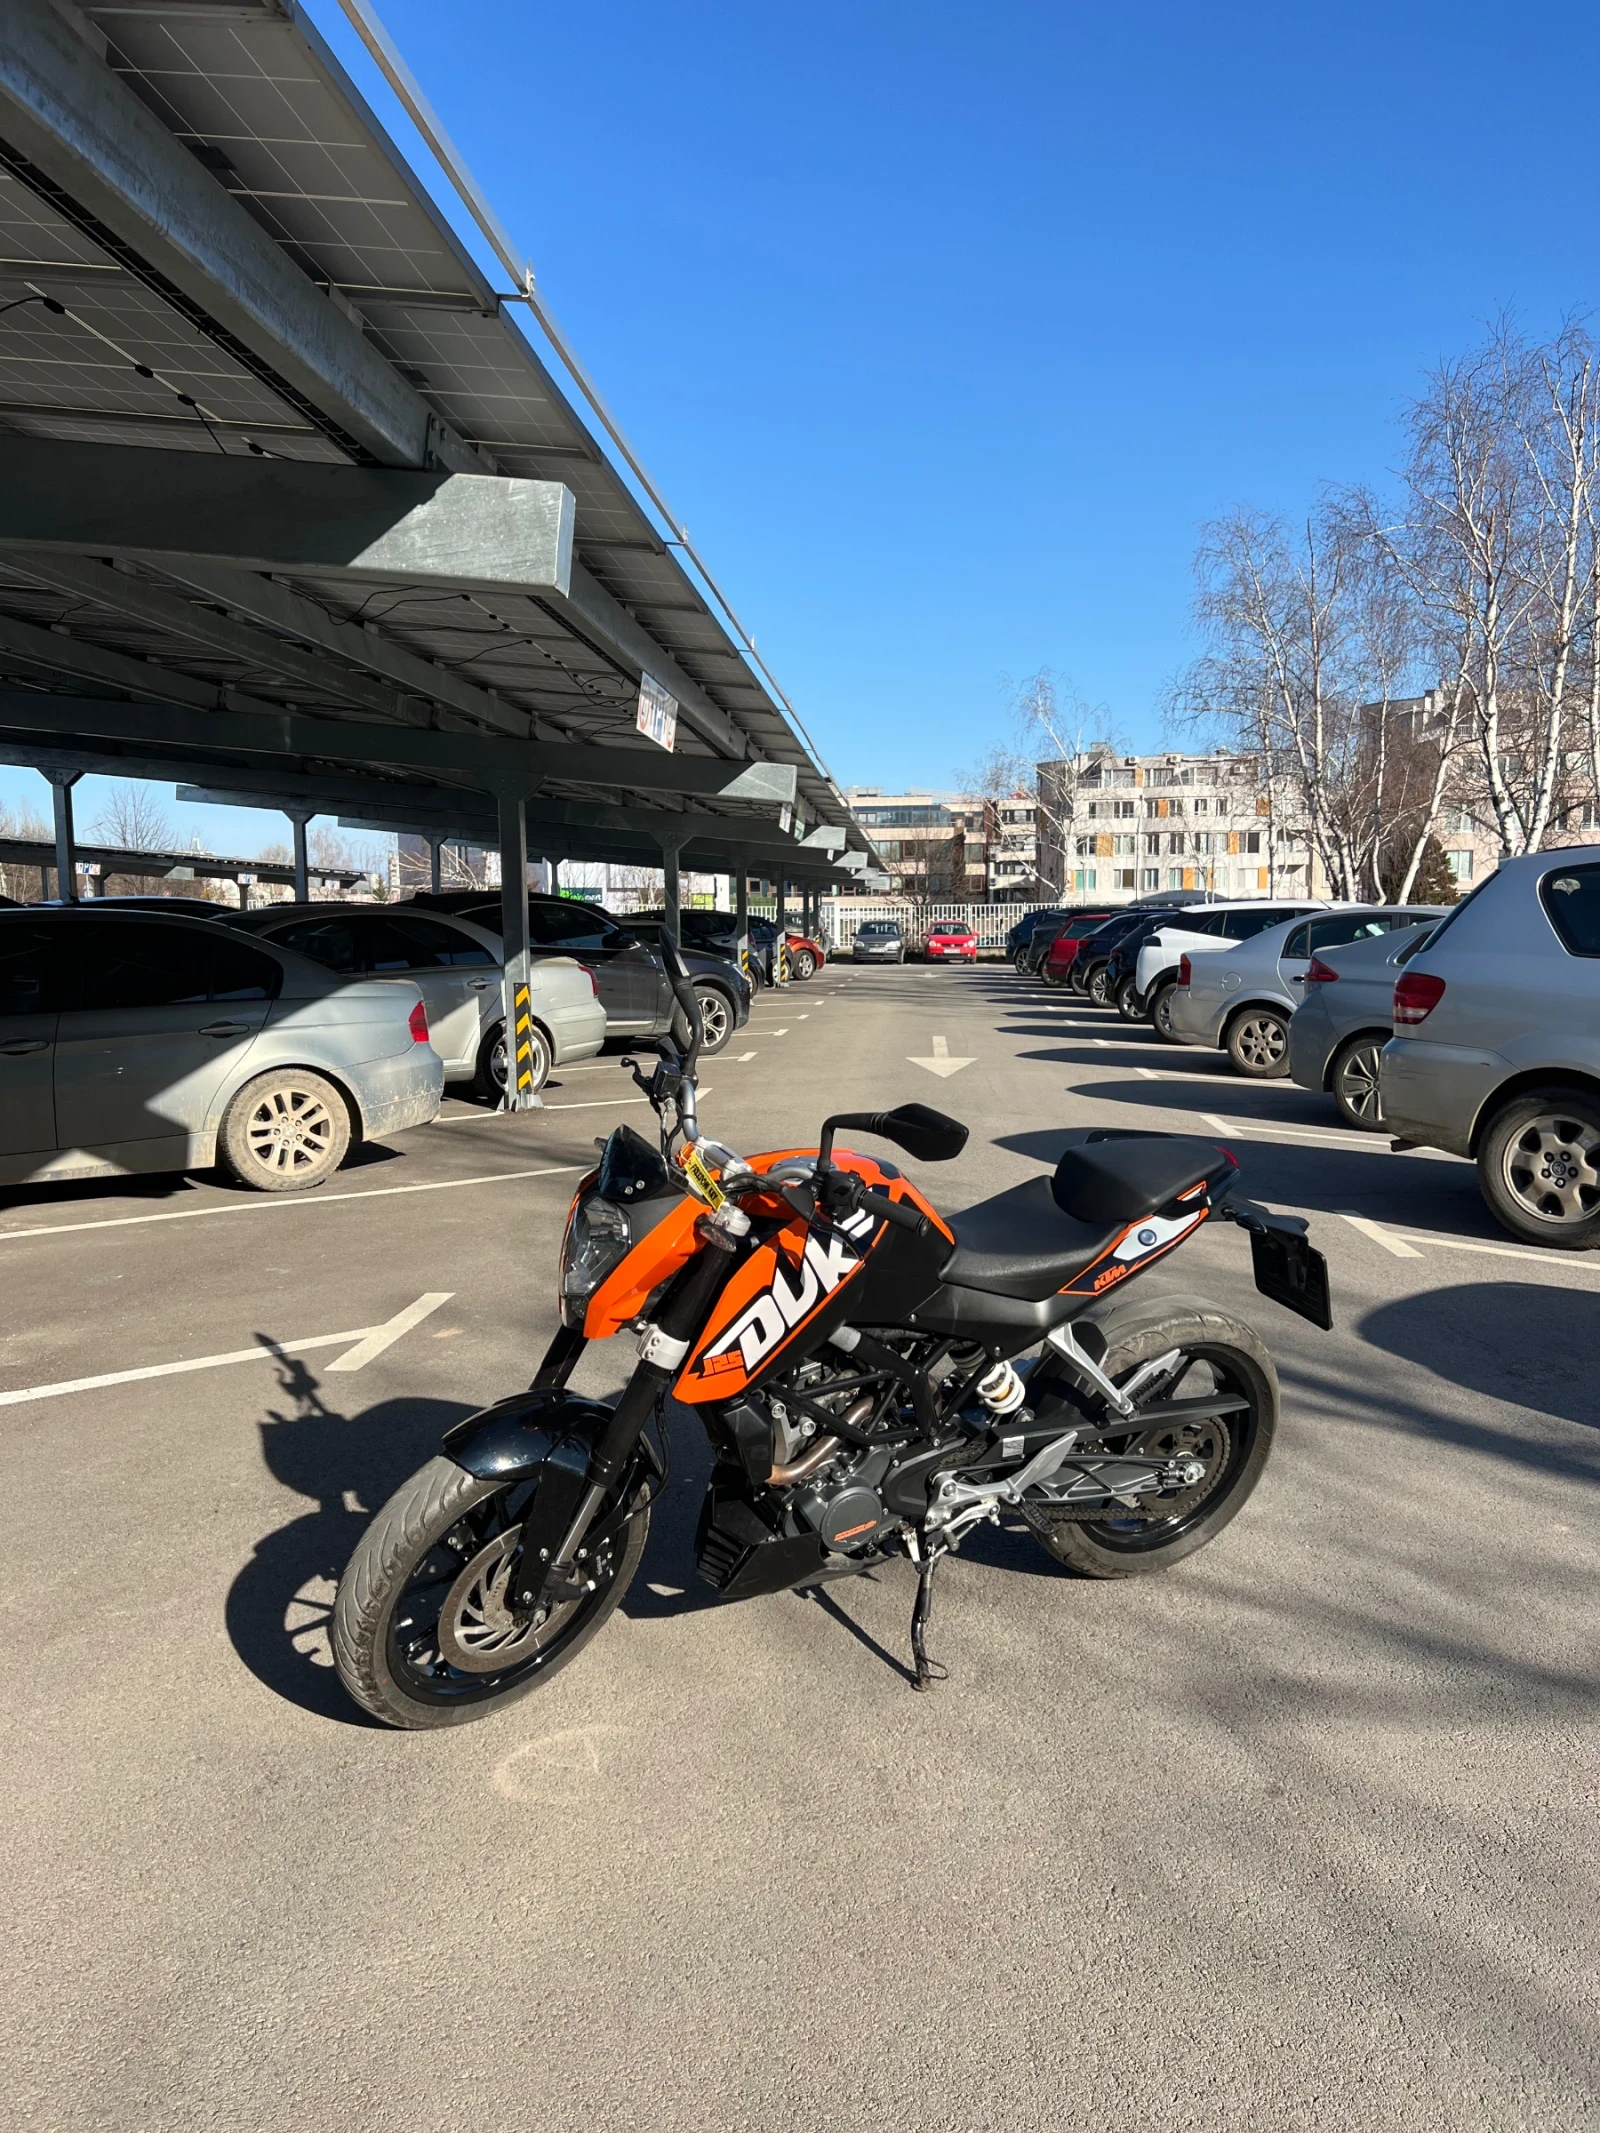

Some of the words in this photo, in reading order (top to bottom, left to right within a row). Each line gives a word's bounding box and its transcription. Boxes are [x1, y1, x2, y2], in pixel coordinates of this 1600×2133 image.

[690, 1163, 710, 1191] FREEDOM
[708, 1186, 719, 1201] KEY
[1093, 1263, 1127, 1291] KTM
[702, 1349, 745, 1377] 125
